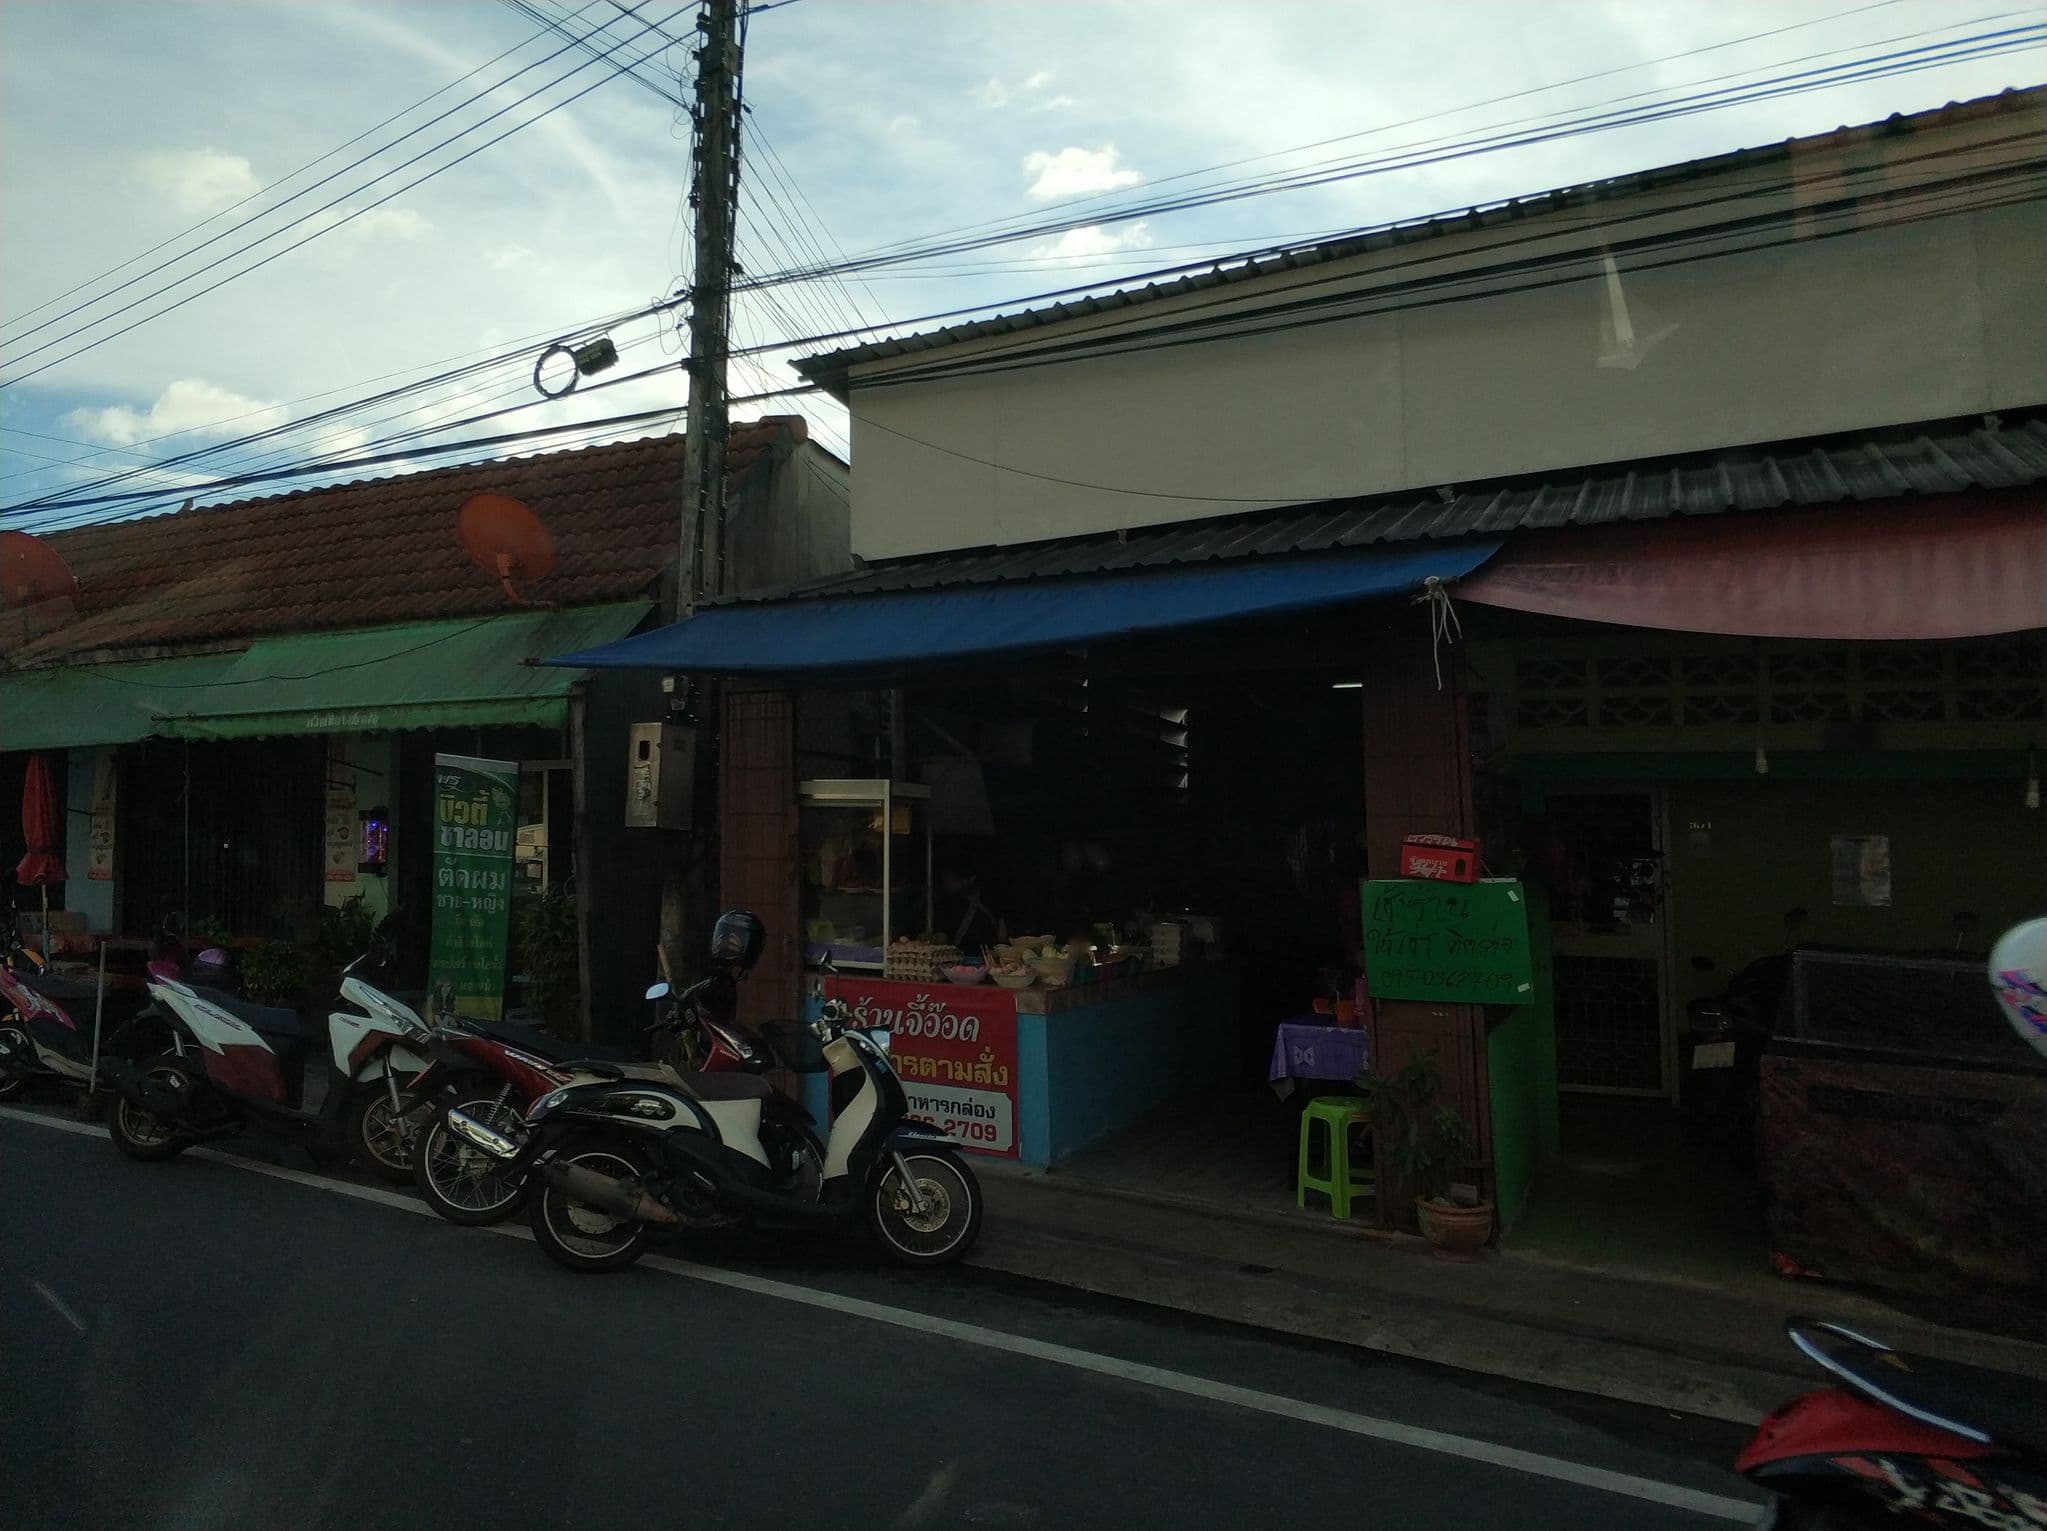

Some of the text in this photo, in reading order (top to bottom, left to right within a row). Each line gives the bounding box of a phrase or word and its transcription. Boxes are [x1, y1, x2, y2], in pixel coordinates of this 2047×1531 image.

[437, 857, 506, 890] ตัดผม
[889, 1045, 1009, 1086] ารตามสั่ง
[907, 1096, 995, 1119] าหารกล่อง
